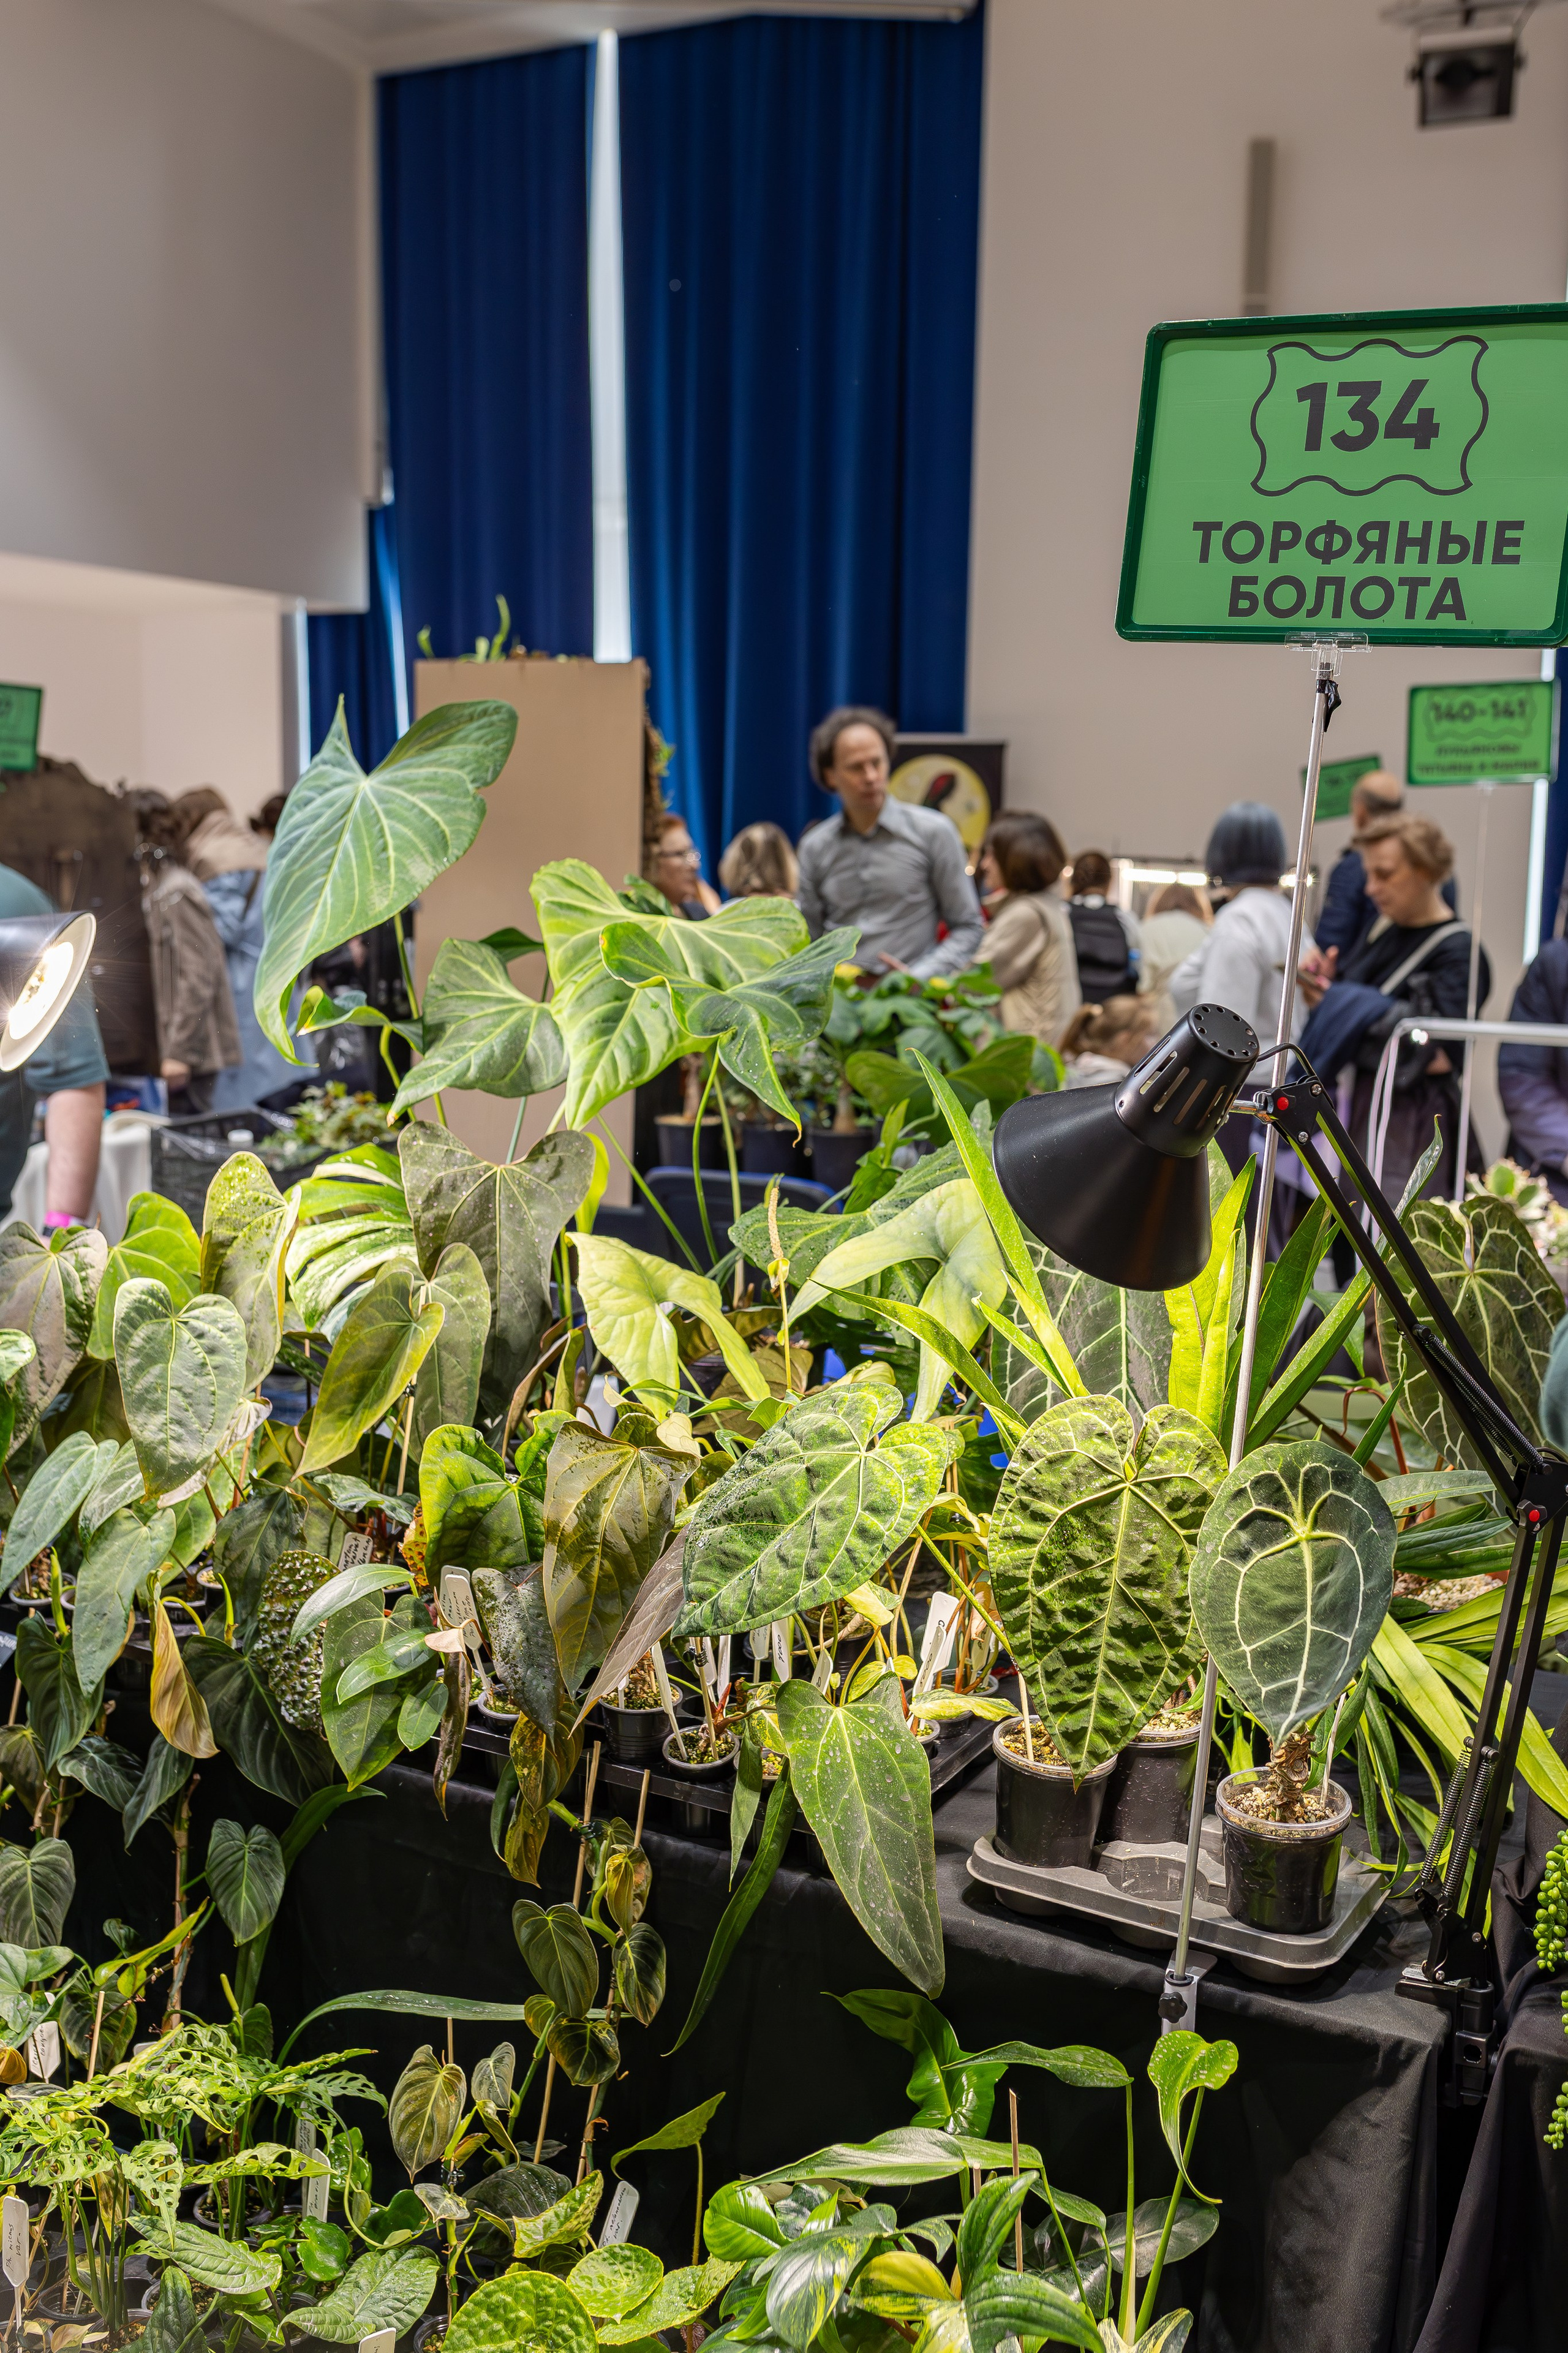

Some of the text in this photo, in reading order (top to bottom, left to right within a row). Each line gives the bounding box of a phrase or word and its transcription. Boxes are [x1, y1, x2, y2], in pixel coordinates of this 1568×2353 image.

[1296, 379, 1441, 452] 134
[1192, 519, 1525, 565] ТОРФЯНЫЕ
[1227, 575, 1467, 621] БОЛОТА
